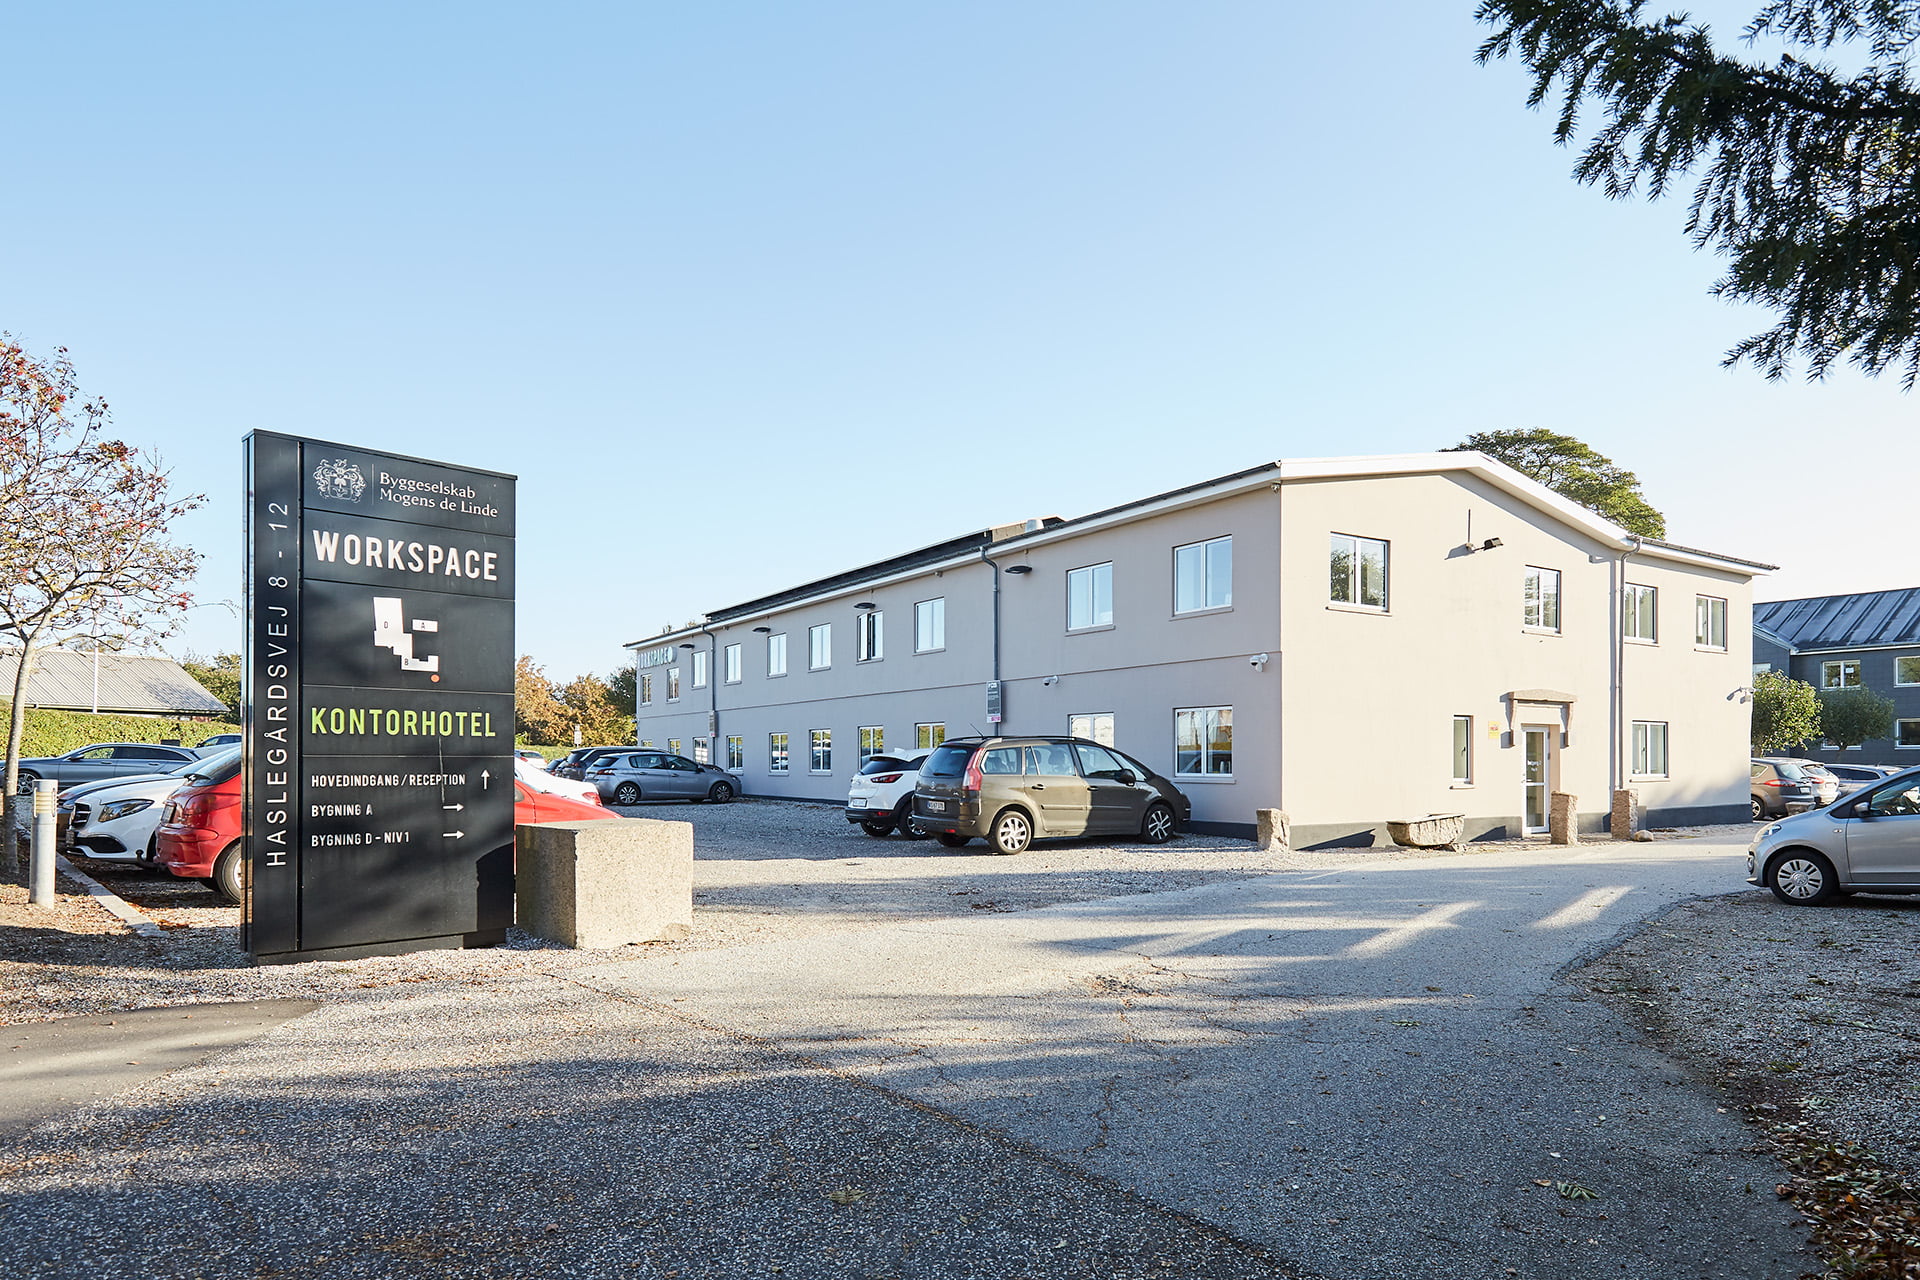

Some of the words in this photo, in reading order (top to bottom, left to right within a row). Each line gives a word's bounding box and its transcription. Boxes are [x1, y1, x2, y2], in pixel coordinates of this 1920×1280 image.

[379, 471, 476, 499] Byggeselskab
[268, 502, 288, 531] 12
[379, 487, 436, 509] Mogens
[439, 496, 457, 512] de
[460, 500, 498, 518] Linde
[312, 529, 498, 581] WORKSPACE
[268, 576, 288, 588] 8
[263, 606, 288, 866] HASLEGÅRDSVEJ
[311, 707, 496, 737] KONTORHOTEL
[311, 804, 362, 817] BYGNING
[365, 803, 373, 816] A
[311, 833, 361, 847] BYGNING
[365, 832, 372, 845] D
